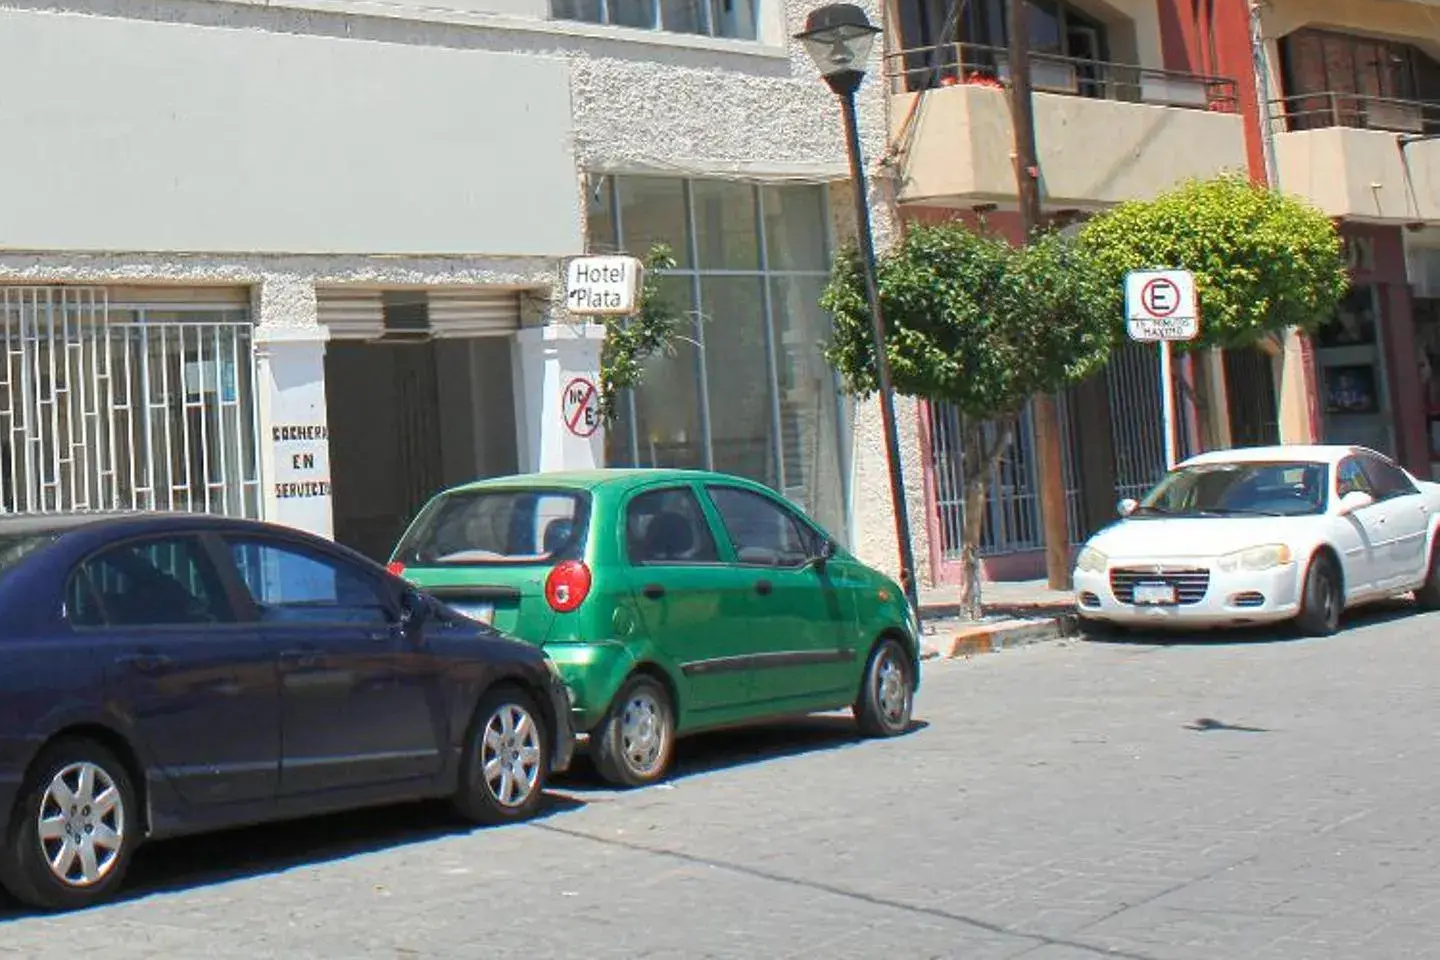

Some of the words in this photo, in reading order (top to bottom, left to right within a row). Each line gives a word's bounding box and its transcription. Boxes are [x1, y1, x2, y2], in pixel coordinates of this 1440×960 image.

[576, 262, 625, 283] Hotel
[576, 288, 621, 308] Plata
[1151, 284, 1170, 310] E
[585, 407, 594, 425] E
[293, 454, 314, 469] EN
